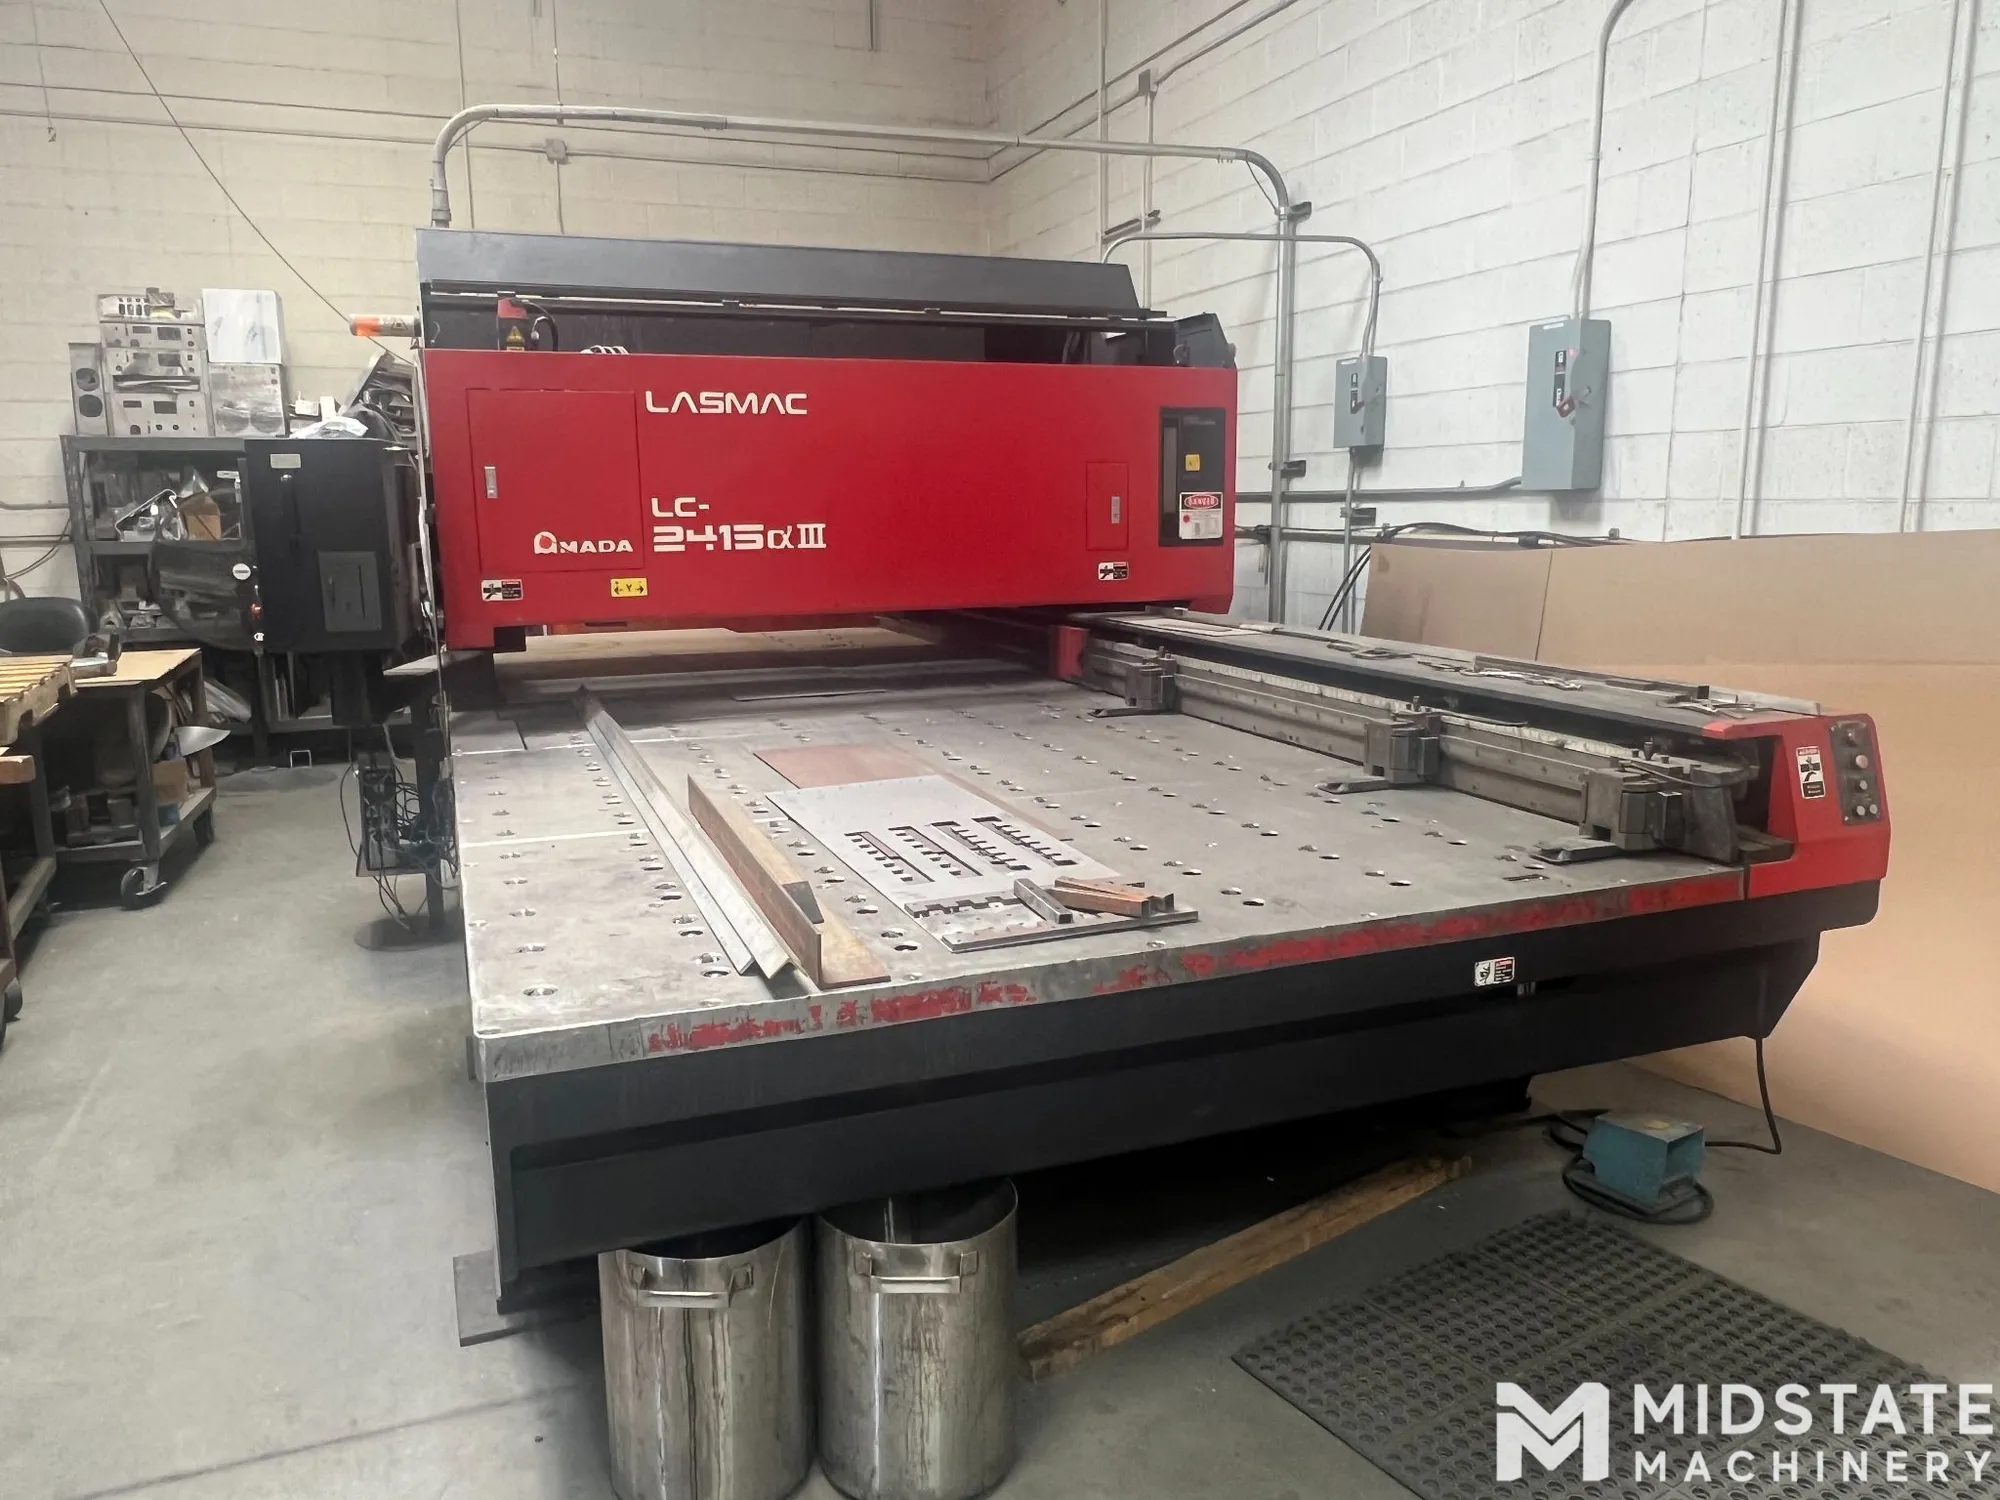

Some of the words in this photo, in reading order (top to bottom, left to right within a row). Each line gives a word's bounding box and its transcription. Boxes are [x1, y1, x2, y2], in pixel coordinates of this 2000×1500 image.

[645, 390, 808, 415] LASMAC
[651, 497, 710, 518] LC-
[533, 531, 634, 554] AMADA
